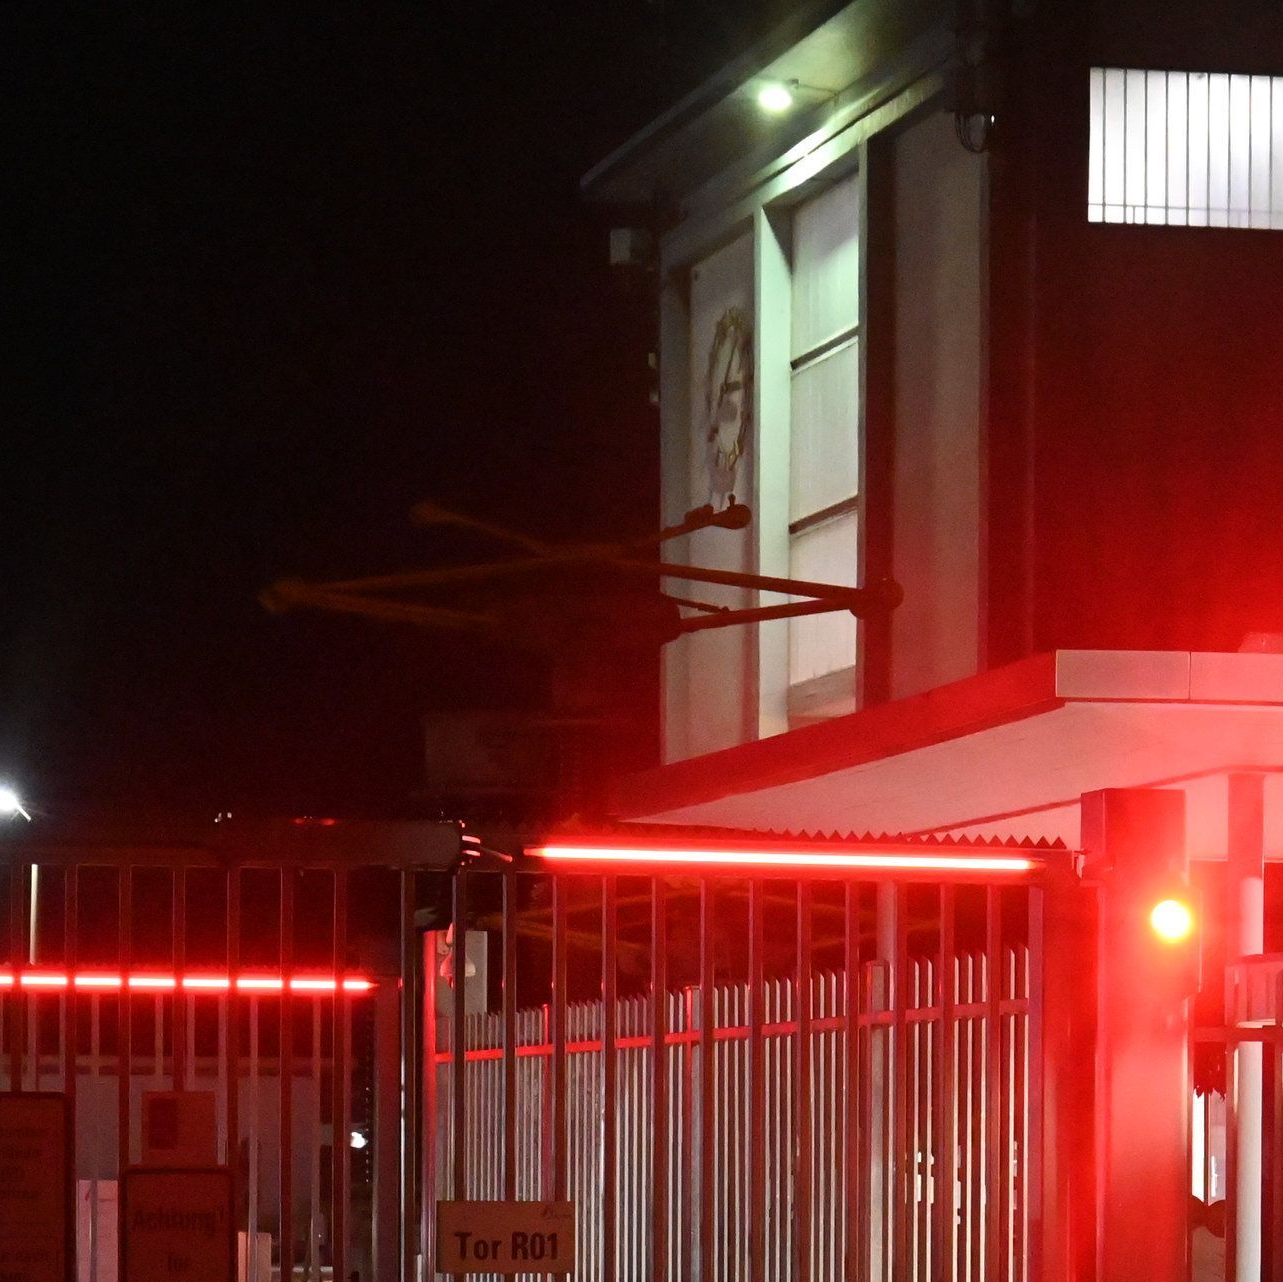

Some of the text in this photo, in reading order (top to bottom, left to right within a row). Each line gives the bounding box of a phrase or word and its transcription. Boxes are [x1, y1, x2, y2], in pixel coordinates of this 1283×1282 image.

[132, 1206, 224, 1239] Achtung!
[454, 1231, 558, 1261] Tor R01
